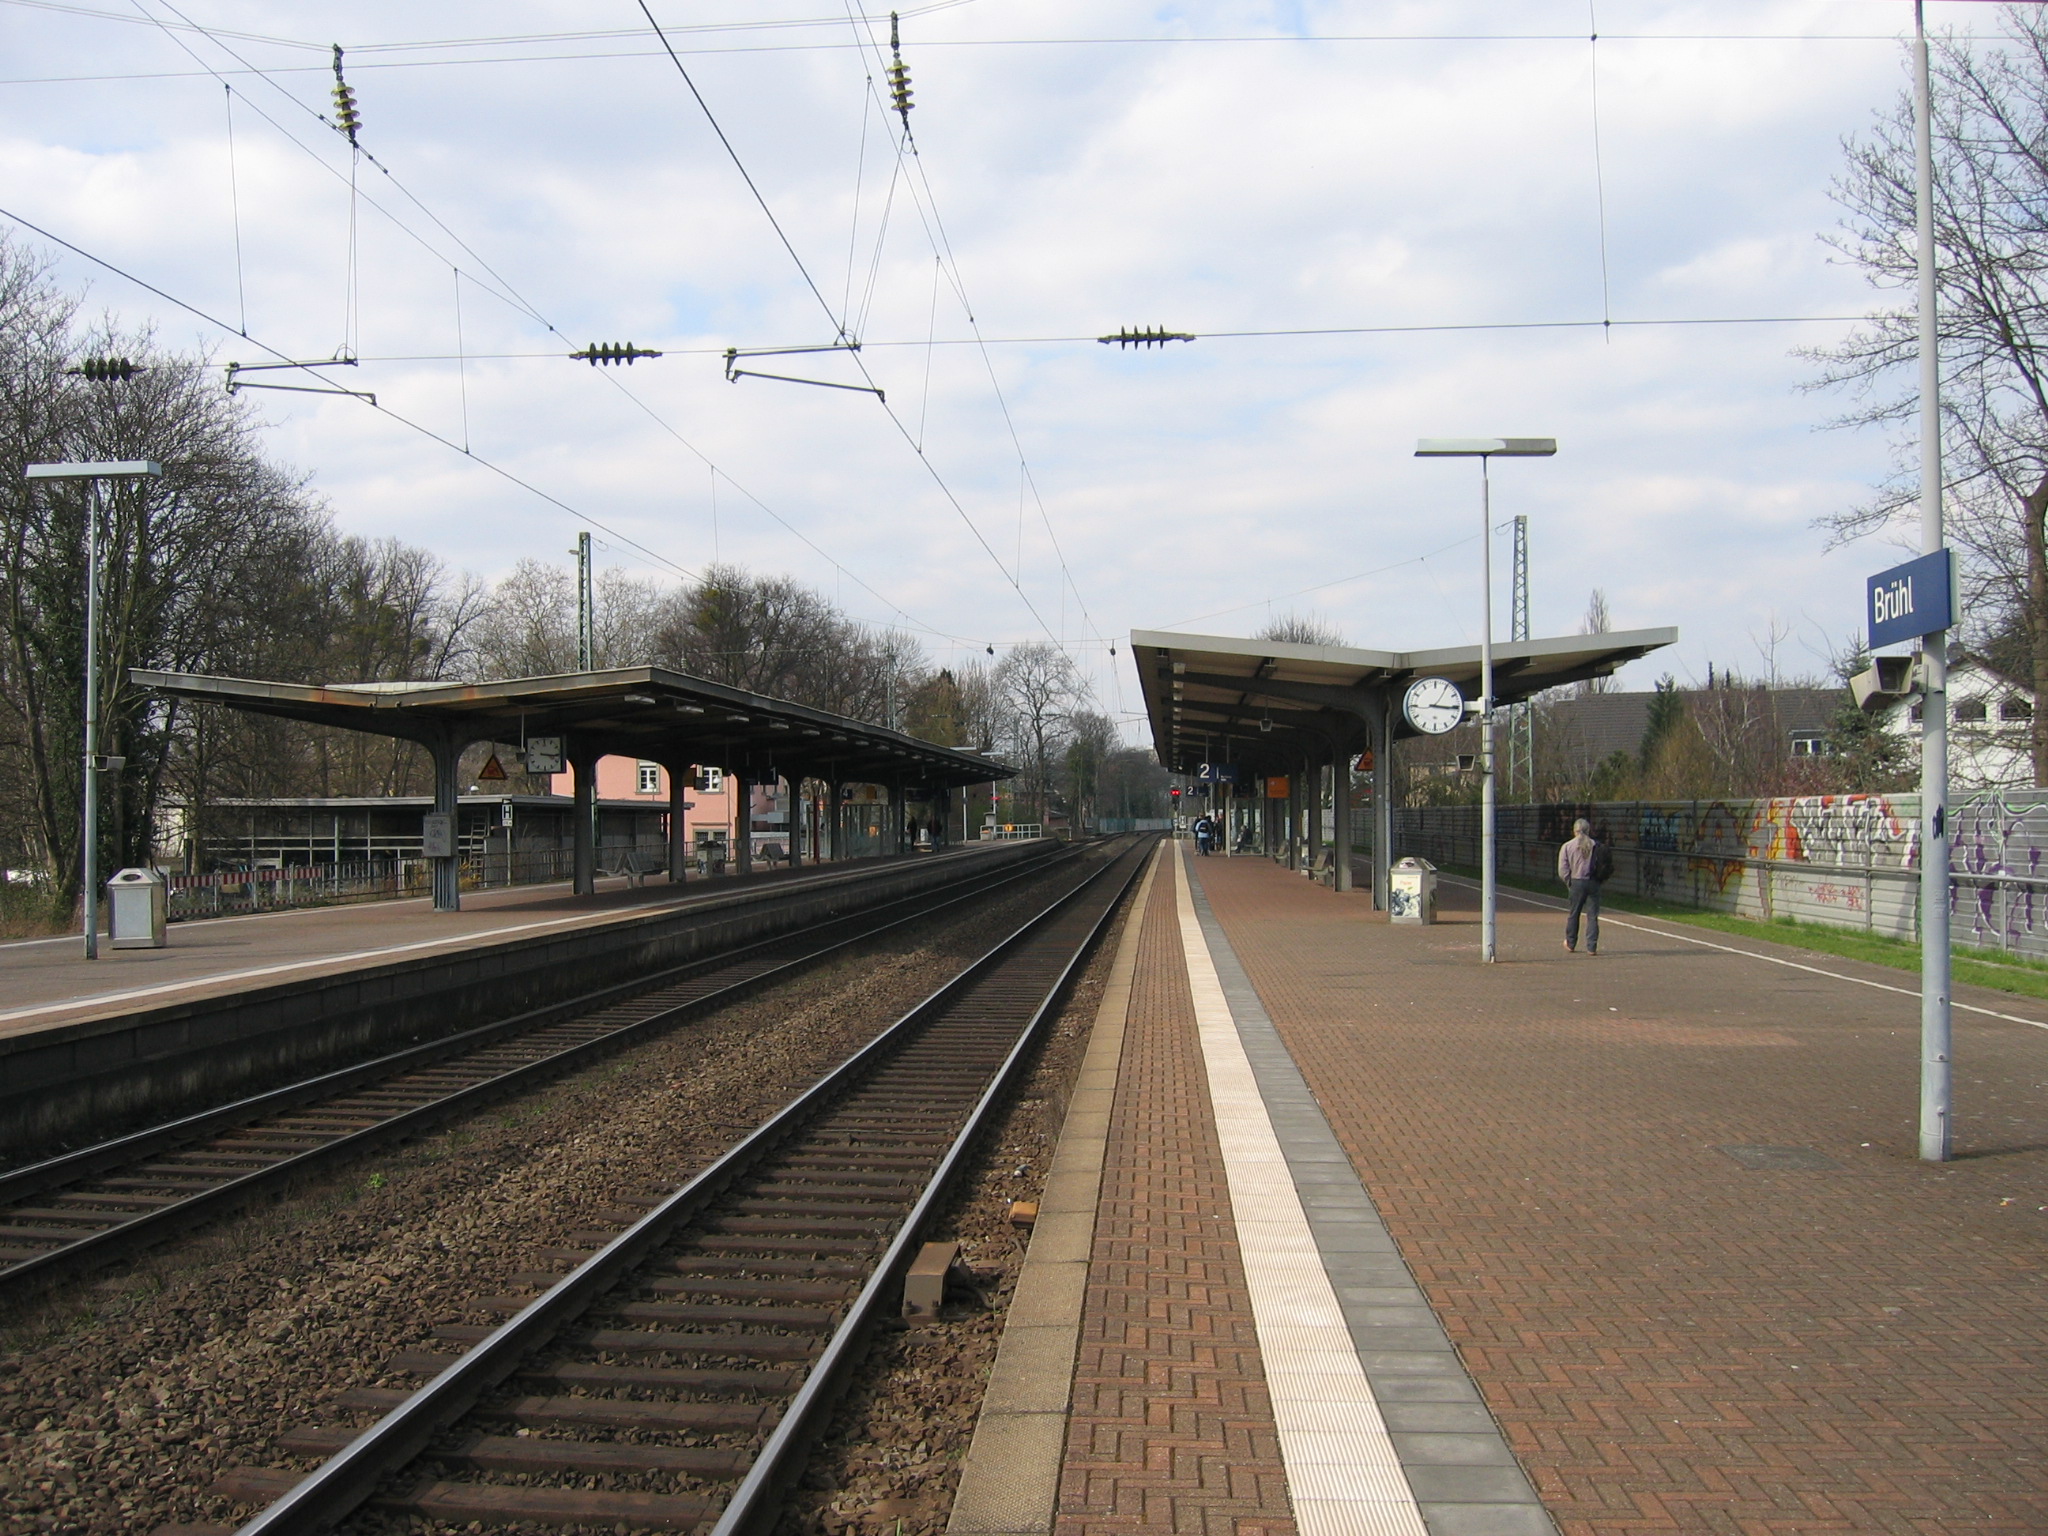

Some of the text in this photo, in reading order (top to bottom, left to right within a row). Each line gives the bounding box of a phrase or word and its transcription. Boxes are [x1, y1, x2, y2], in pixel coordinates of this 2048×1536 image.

[1874, 575, 1914, 624] Brühl
[770, 766, 777, 781] 1
[1200, 763, 1210, 779] 2
[1187, 786, 1194, 795] 2
[503, 805, 511, 819] H
